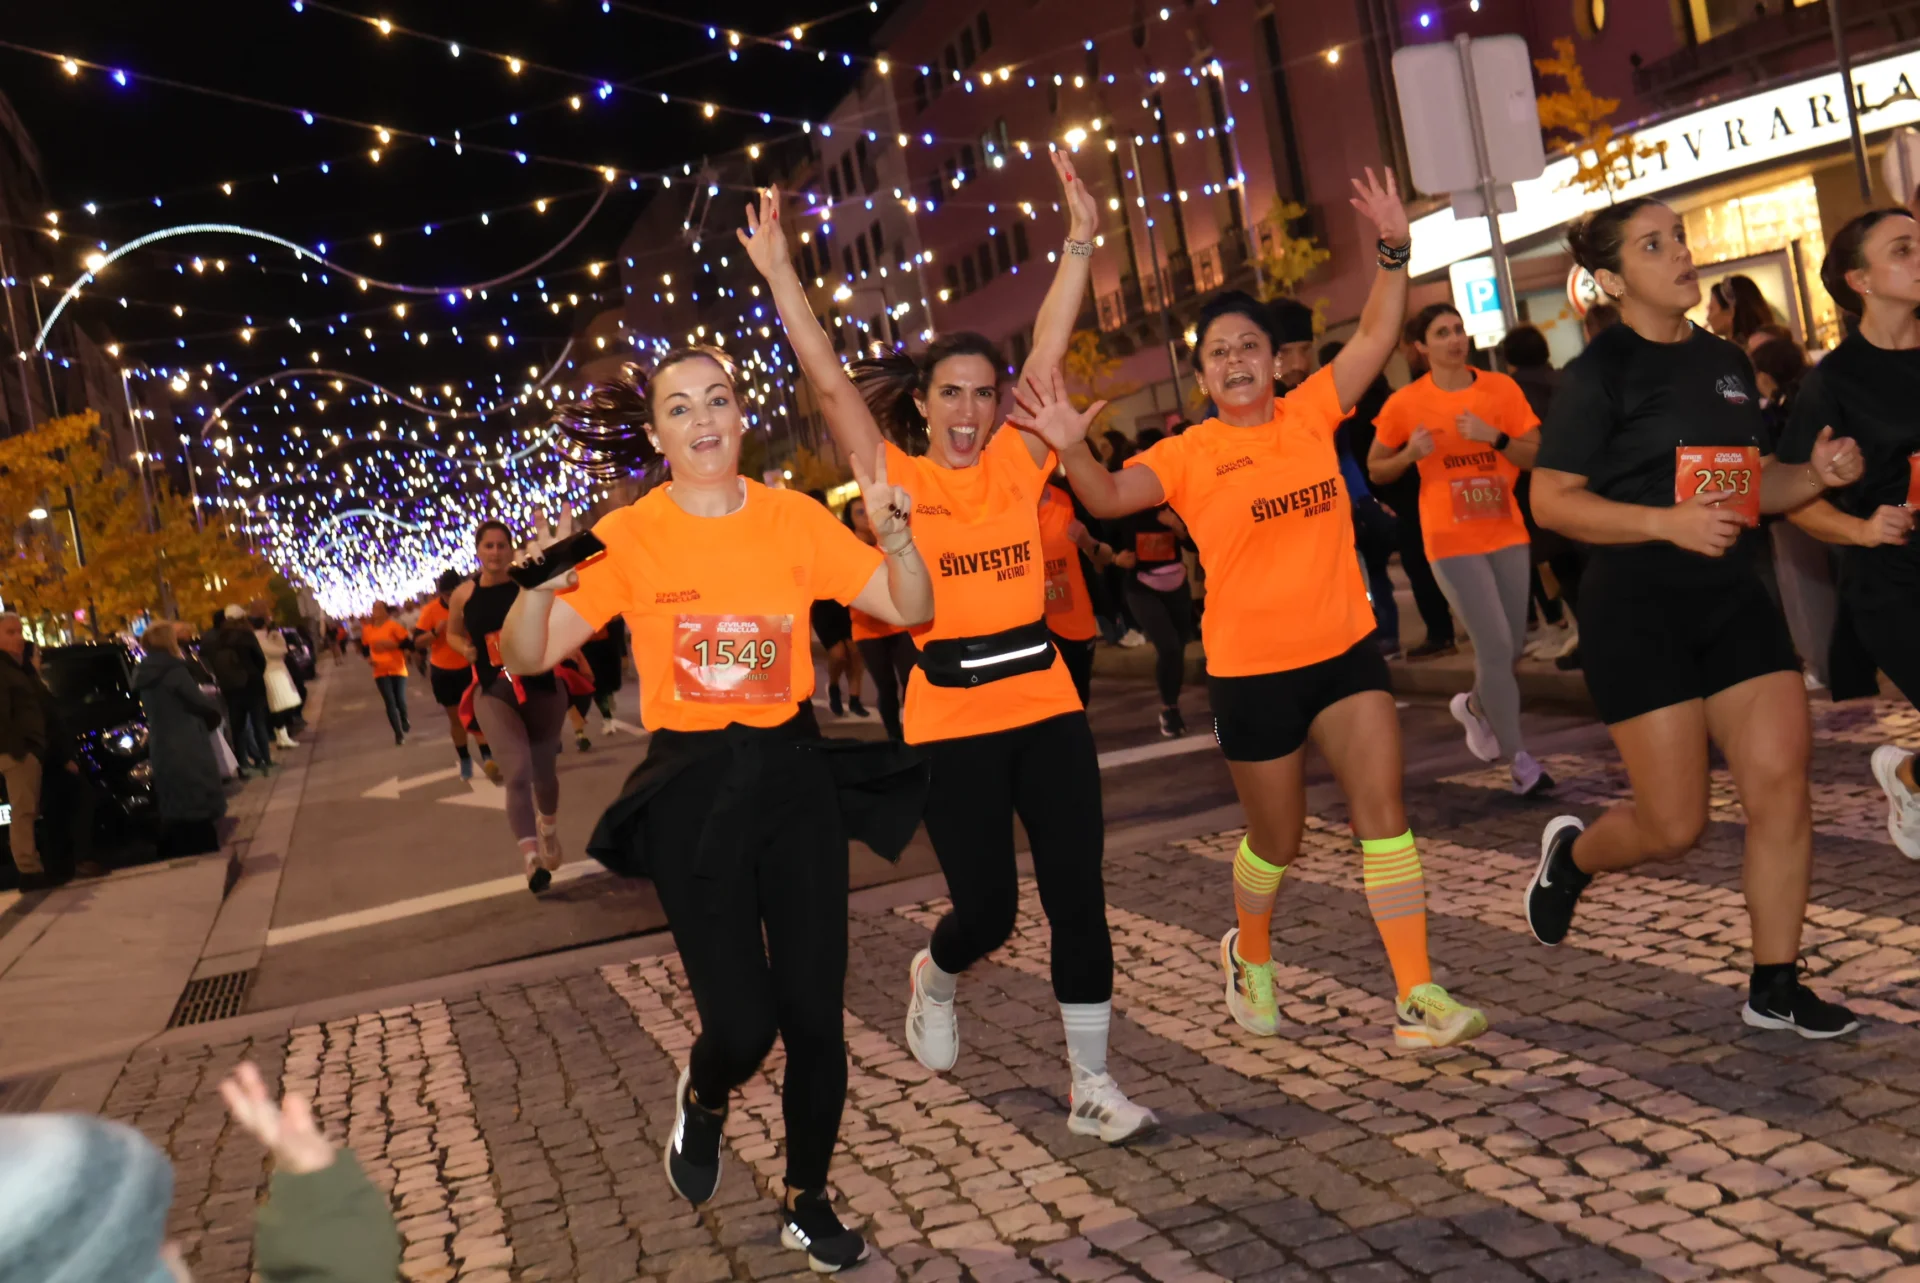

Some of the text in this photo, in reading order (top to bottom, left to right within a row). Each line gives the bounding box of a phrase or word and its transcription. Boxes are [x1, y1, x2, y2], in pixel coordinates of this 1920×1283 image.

[1470, 281, 1494, 313] P
[1461, 487, 1502, 504] 1052
[1694, 469, 1752, 495] 2353
[1251, 477, 1338, 523] SILVESTRE
[1304, 501, 1331, 518] AVEIRO
[939, 540, 1031, 577] SILVESTRE
[996, 564, 1025, 582] AVEIRO
[694, 639, 777, 670] 1549
